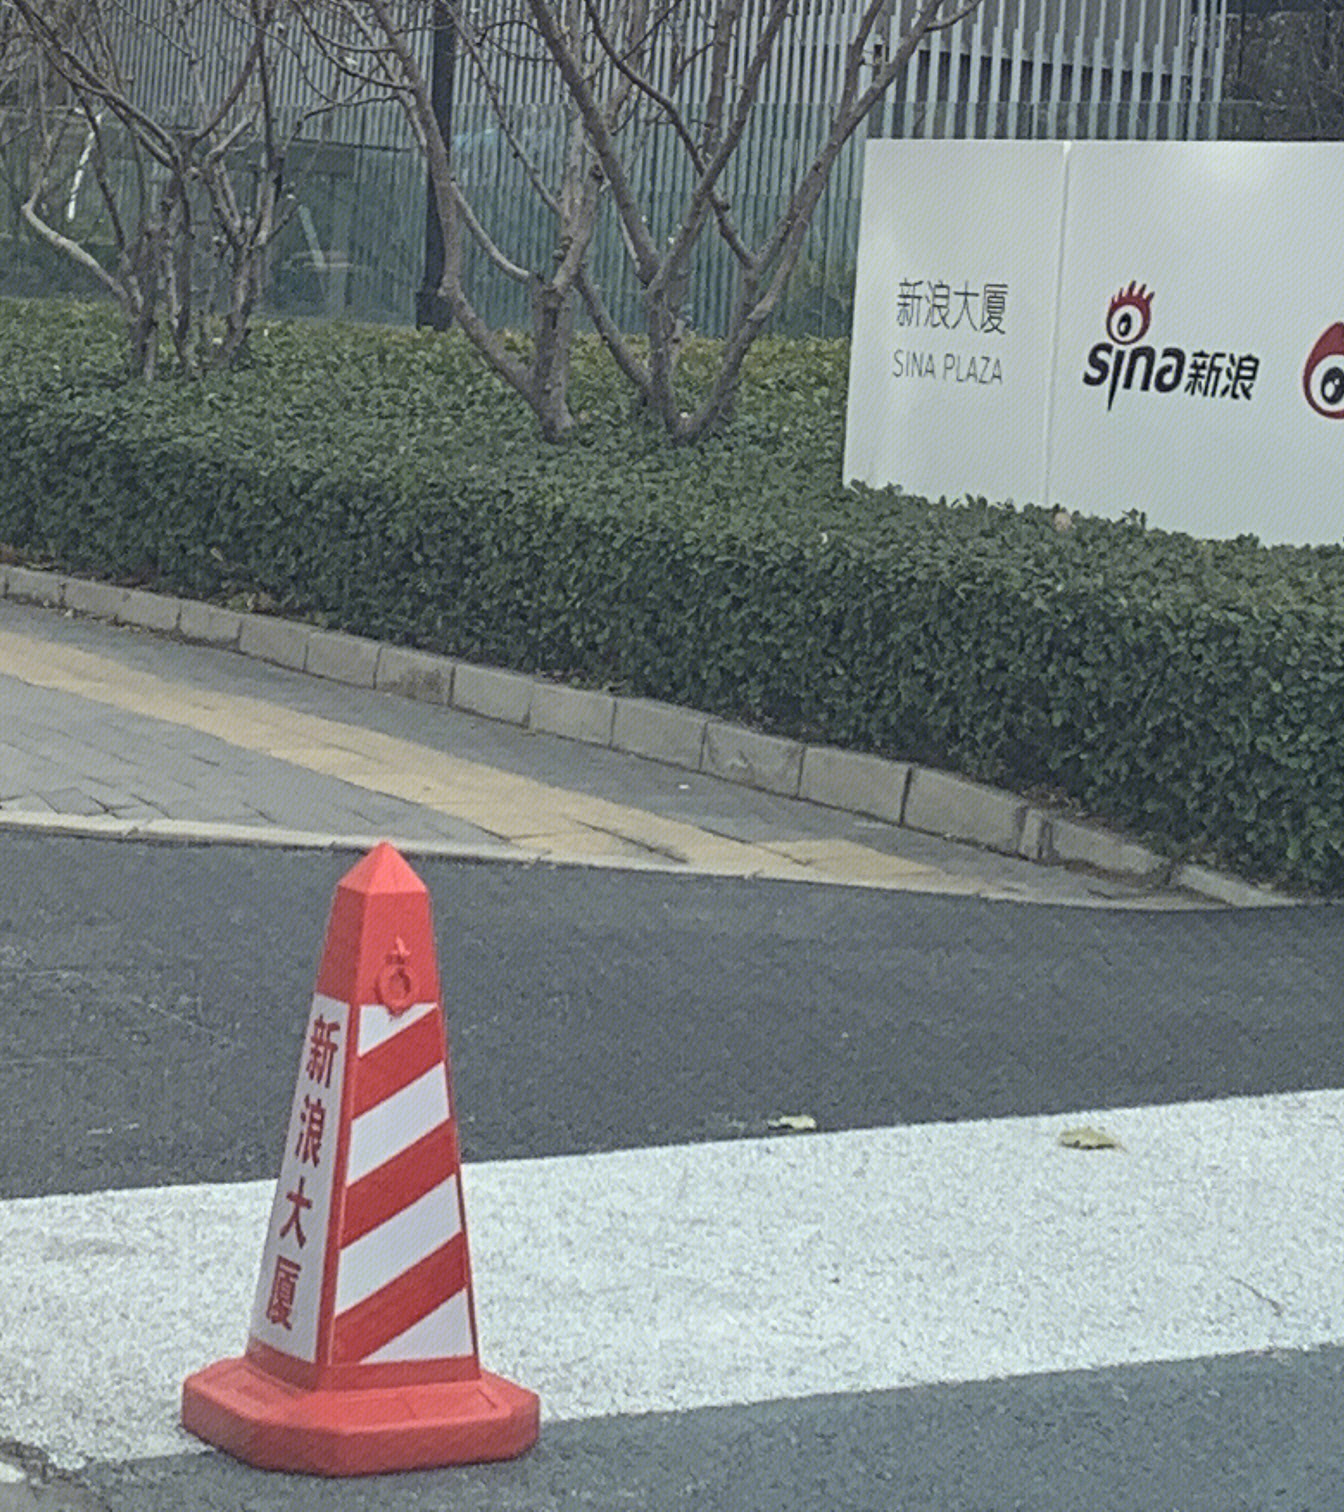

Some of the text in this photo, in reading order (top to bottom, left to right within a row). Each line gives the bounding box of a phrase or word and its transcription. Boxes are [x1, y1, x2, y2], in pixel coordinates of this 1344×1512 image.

[897, 277, 1008, 335] 新浪大厦
[893, 349, 1003, 385] SINA PLAZA
[266, 1013, 341, 1331] 新浪大厦
